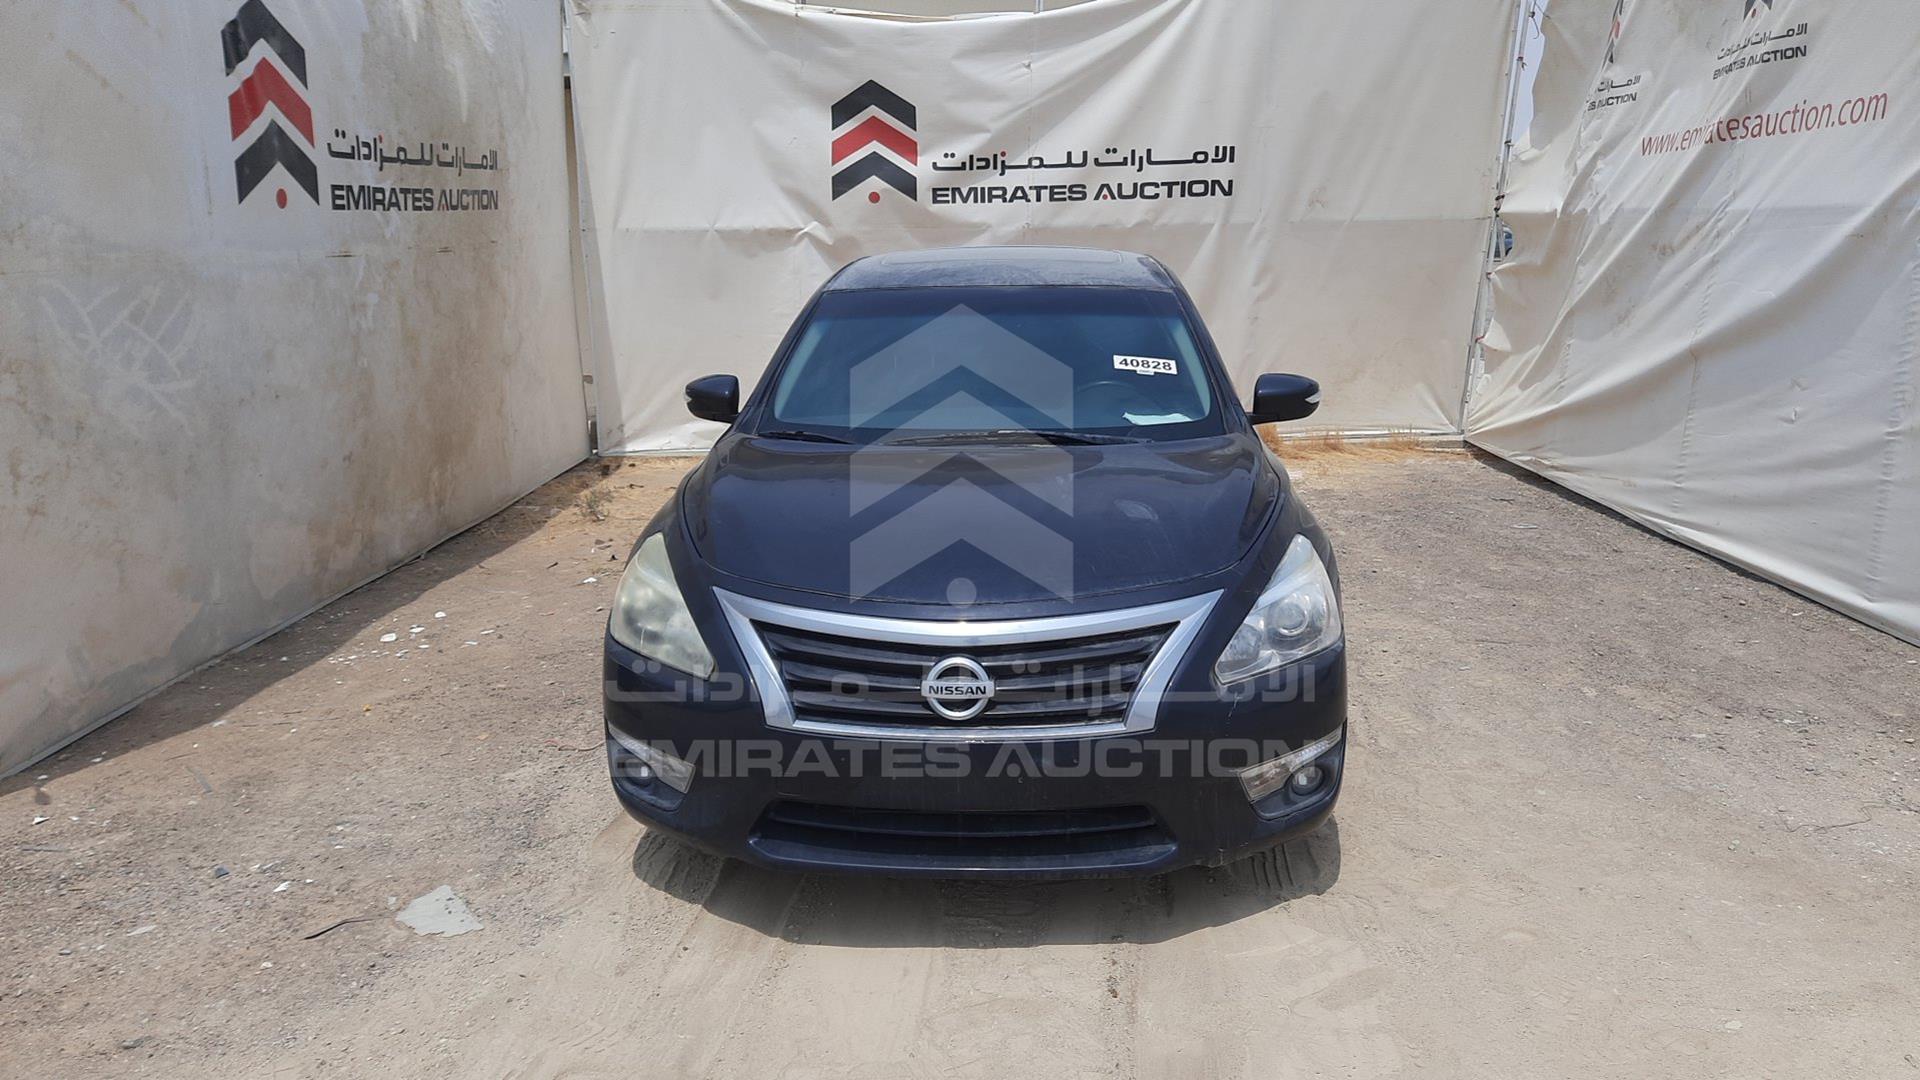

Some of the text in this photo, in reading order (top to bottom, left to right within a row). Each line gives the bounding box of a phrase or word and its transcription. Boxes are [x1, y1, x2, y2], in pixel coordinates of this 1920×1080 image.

[1746, 45, 1807, 67] AUCTION
[331, 184, 499, 211] EMIRATES AUCTION
[931, 179, 1233, 204] EMIRATES AUCTION
[1119, 358, 1172, 371] 40828
[928, 685, 986, 695] NISSAN
